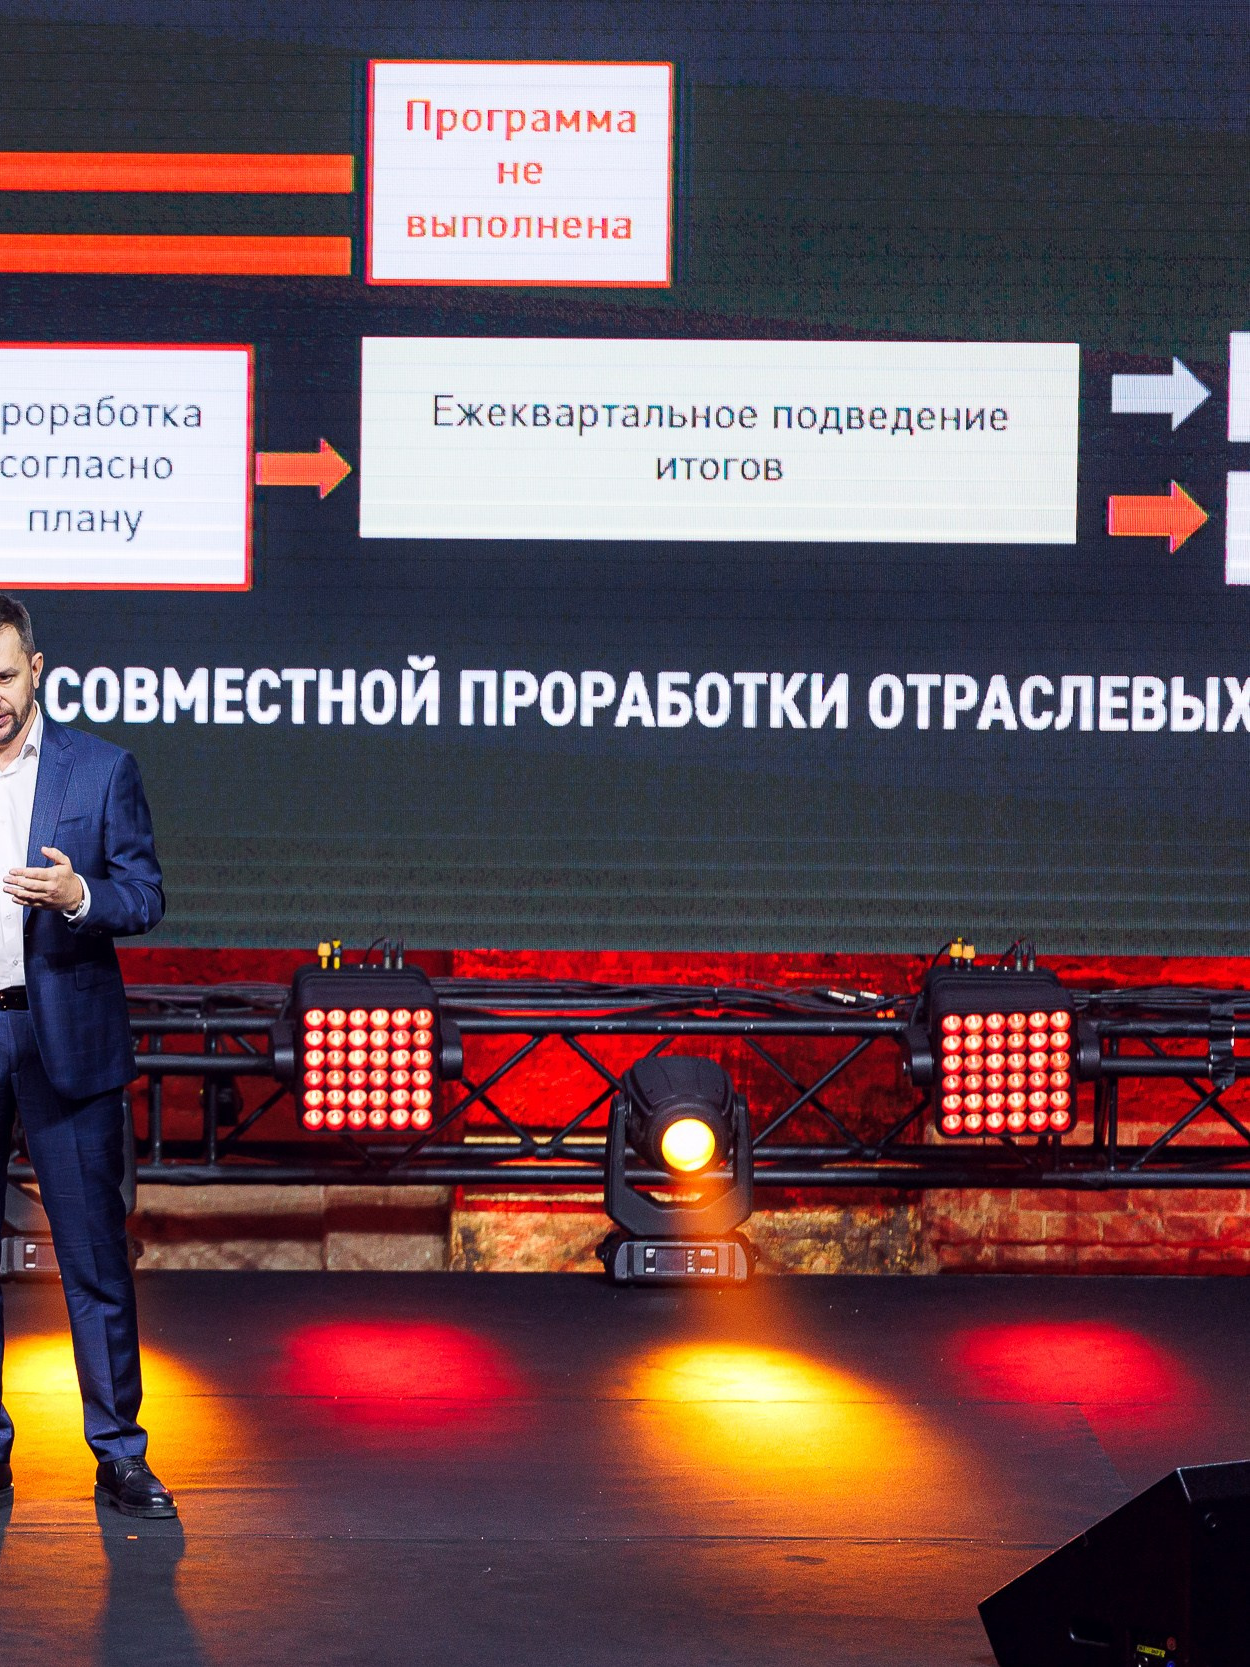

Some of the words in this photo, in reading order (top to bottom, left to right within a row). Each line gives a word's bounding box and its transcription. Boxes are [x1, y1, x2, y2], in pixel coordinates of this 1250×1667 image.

[406, 98, 637, 139] Программа
[497, 162, 543, 185] не
[407, 215, 632, 240] выполнена
[433, 394, 758, 437] Ежеквартальное
[773, 405, 1008, 436] подведение
[0, 455, 173, 480] согласно
[656, 457, 784, 482] итогов
[29, 509, 143, 542] плану
[44, 654, 441, 726] СОВМЕСТНОЙ
[458, 669, 849, 730] ПРОРАБОТКИ
[868, 673, 1250, 733] ОТРАСЛЕВЫХ
